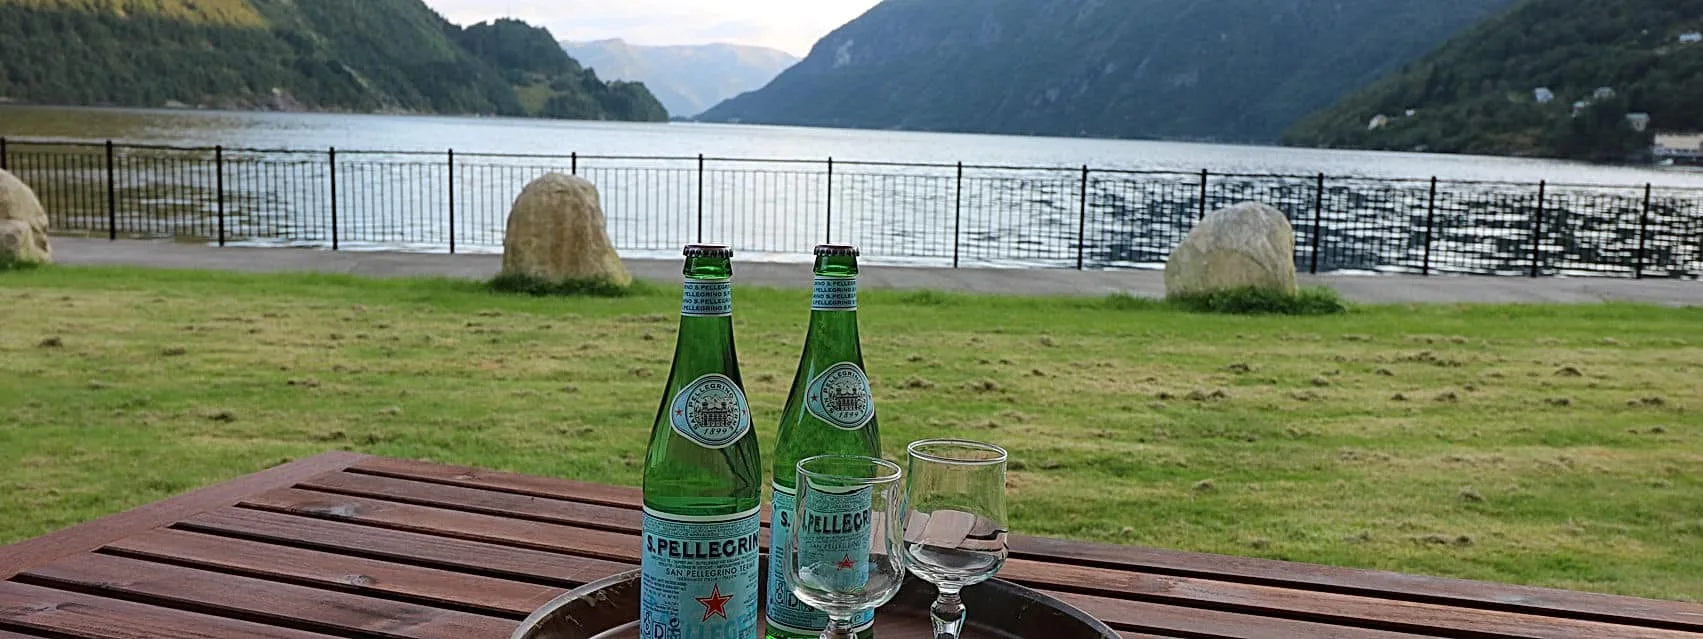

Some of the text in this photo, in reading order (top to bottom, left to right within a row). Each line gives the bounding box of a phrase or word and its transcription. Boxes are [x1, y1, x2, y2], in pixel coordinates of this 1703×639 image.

[688, 383, 734, 408] PELLEGRINO
[688, 411, 699, 430] SAN
[703, 427, 728, 435] 1899
[665, 567, 683, 577] SAN
[686, 567, 737, 578] PELLEGRINO
